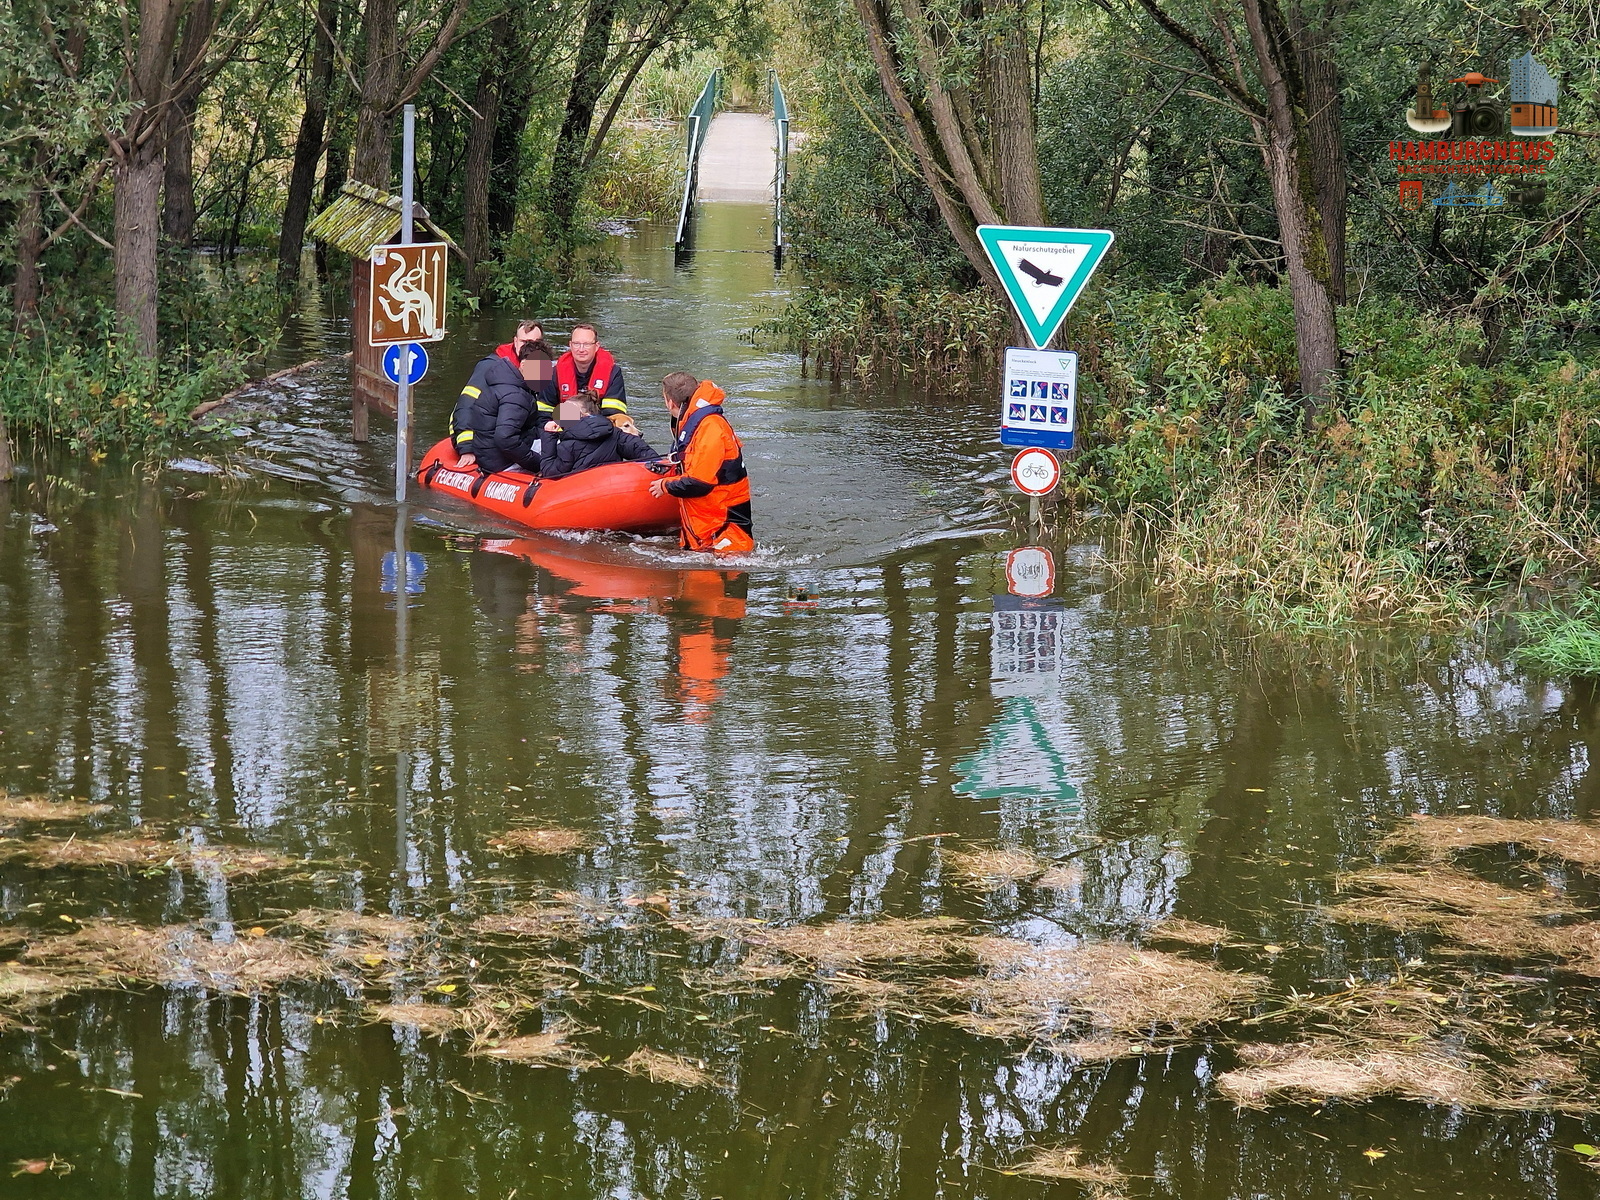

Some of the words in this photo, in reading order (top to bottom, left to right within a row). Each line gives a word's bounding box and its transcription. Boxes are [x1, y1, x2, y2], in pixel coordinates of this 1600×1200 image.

[1012, 245, 1076, 255] Naturschutzgebiet
[435, 468, 475, 492] FEUERWEHR
[484, 480, 521, 503] HAMBURG
